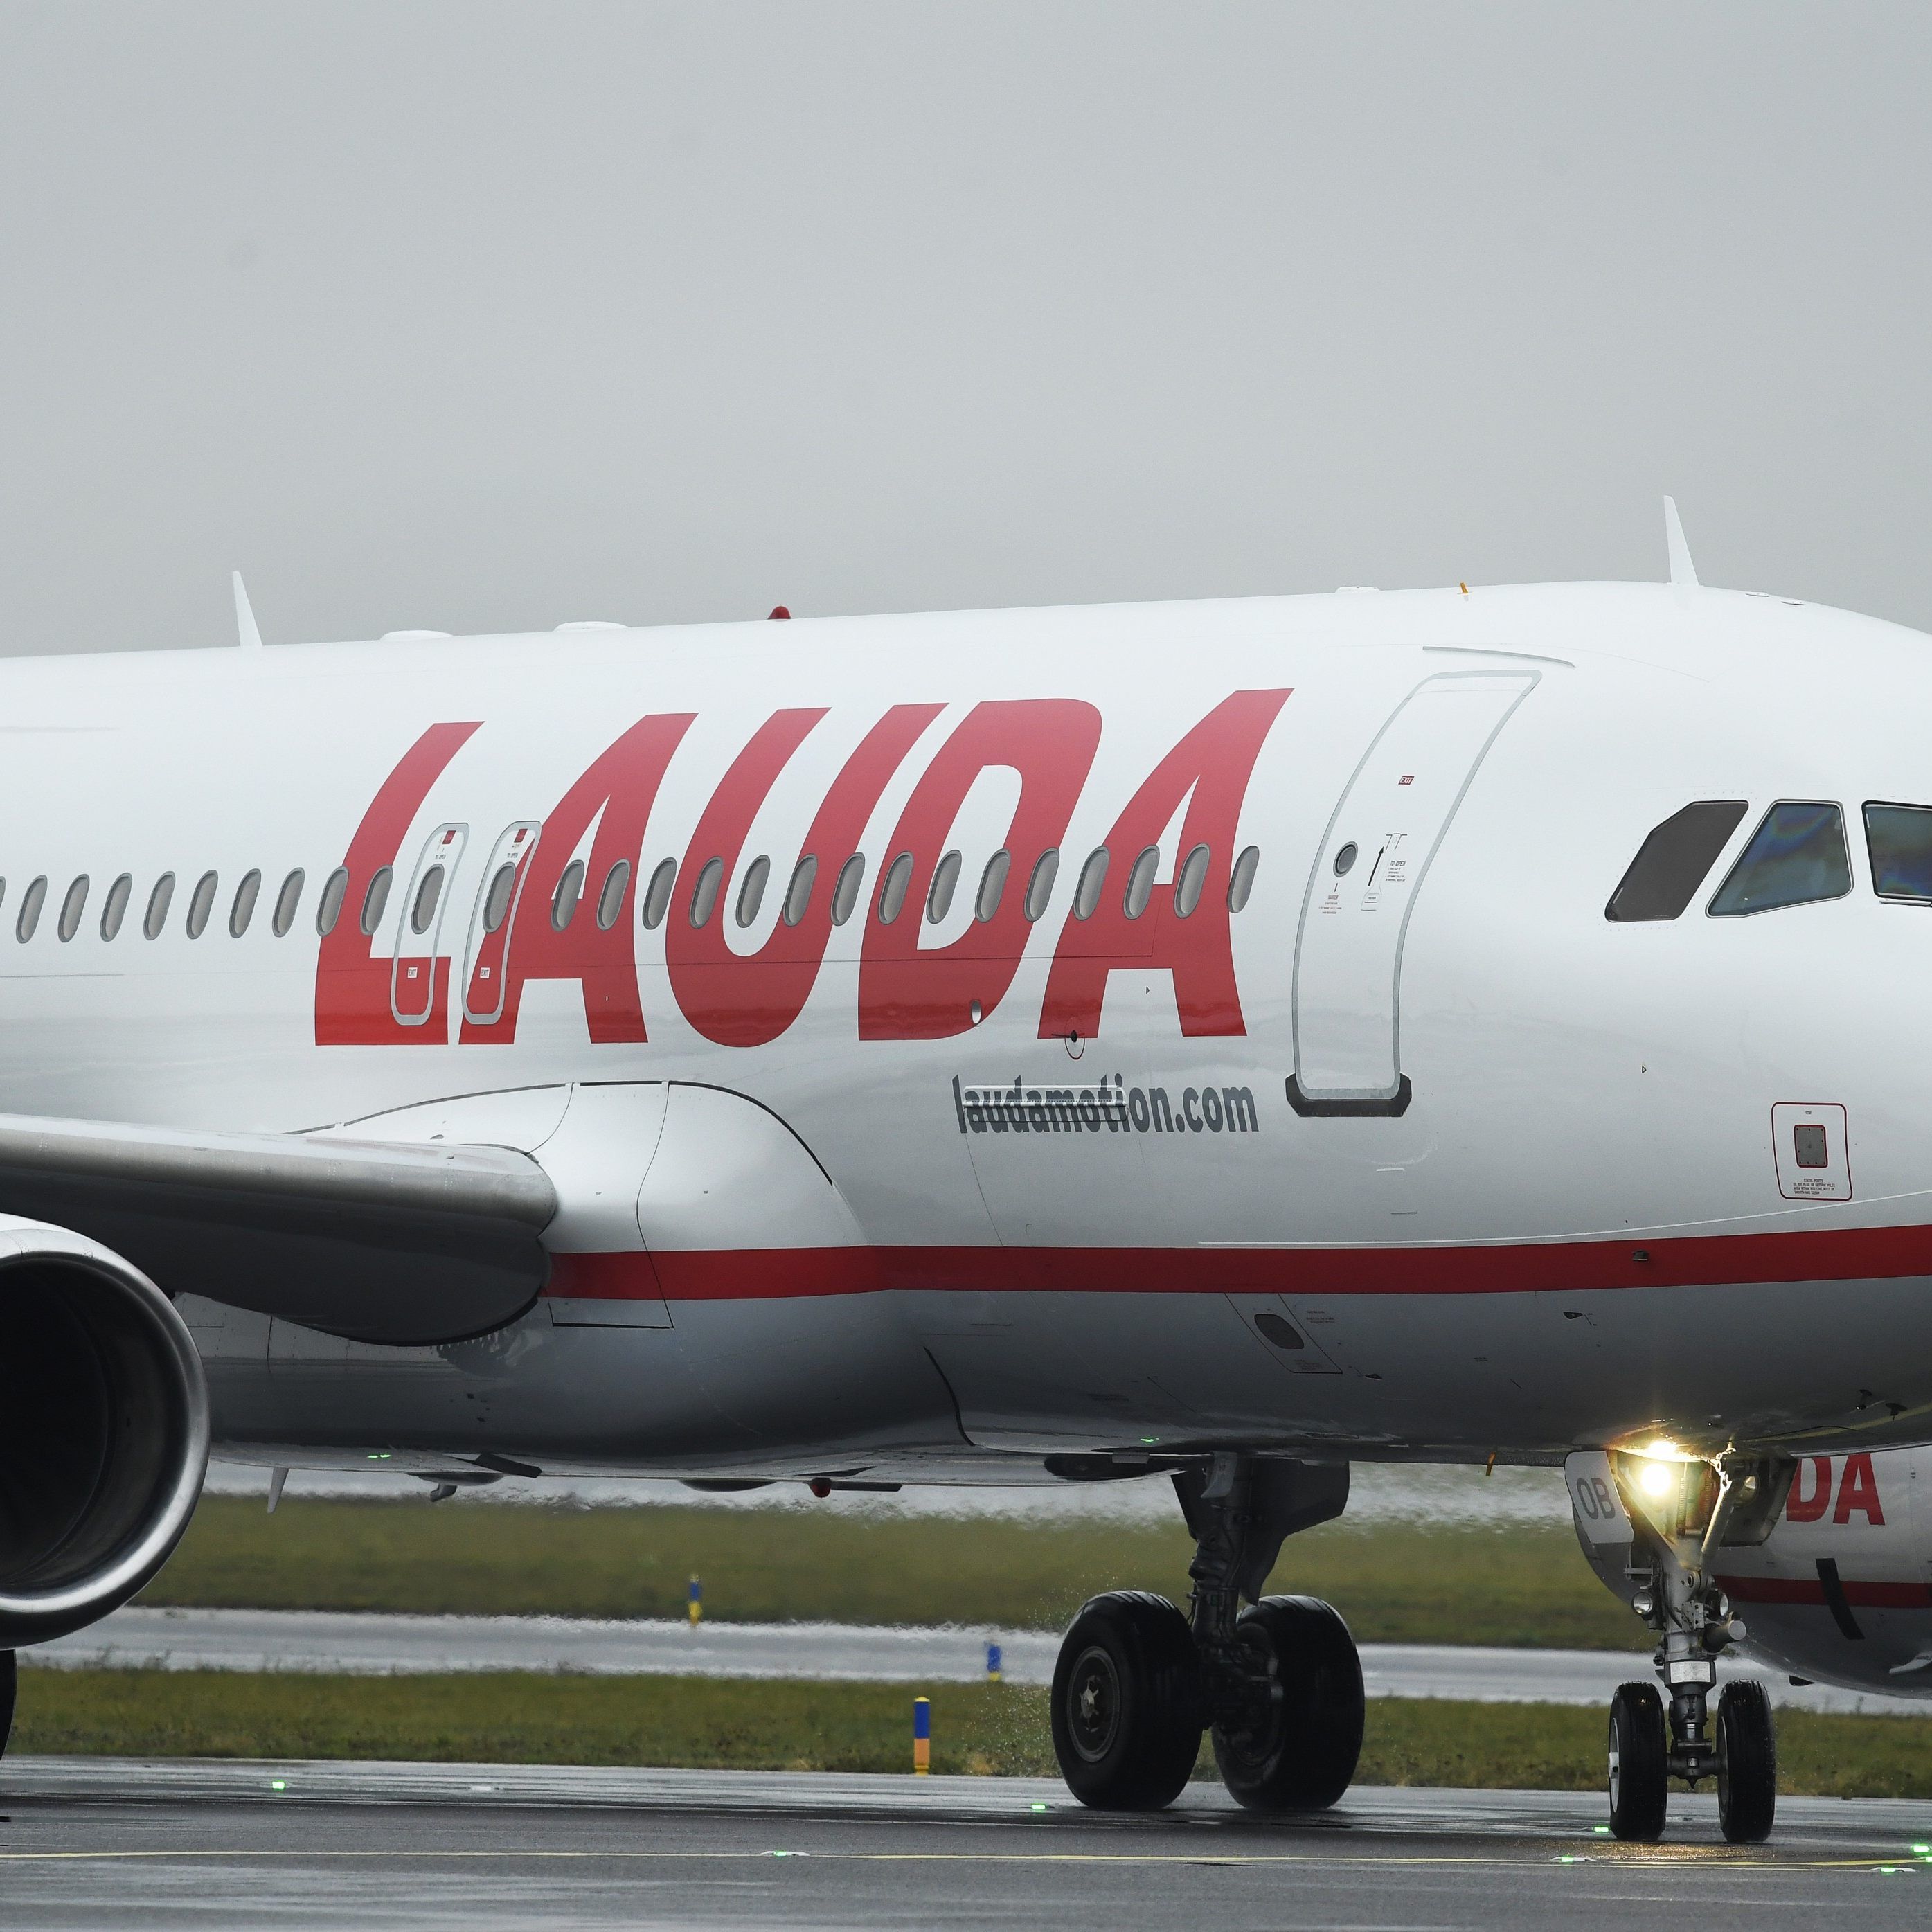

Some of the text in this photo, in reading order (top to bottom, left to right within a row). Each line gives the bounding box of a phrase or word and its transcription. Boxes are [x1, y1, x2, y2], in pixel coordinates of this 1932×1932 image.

[1399, 776, 1414, 784] EXIT
[315, 688, 1295, 1047] LAUDA
[951, 1073, 1260, 1134] laudamotion.com
[1576, 1478, 1616, 1520] OB
